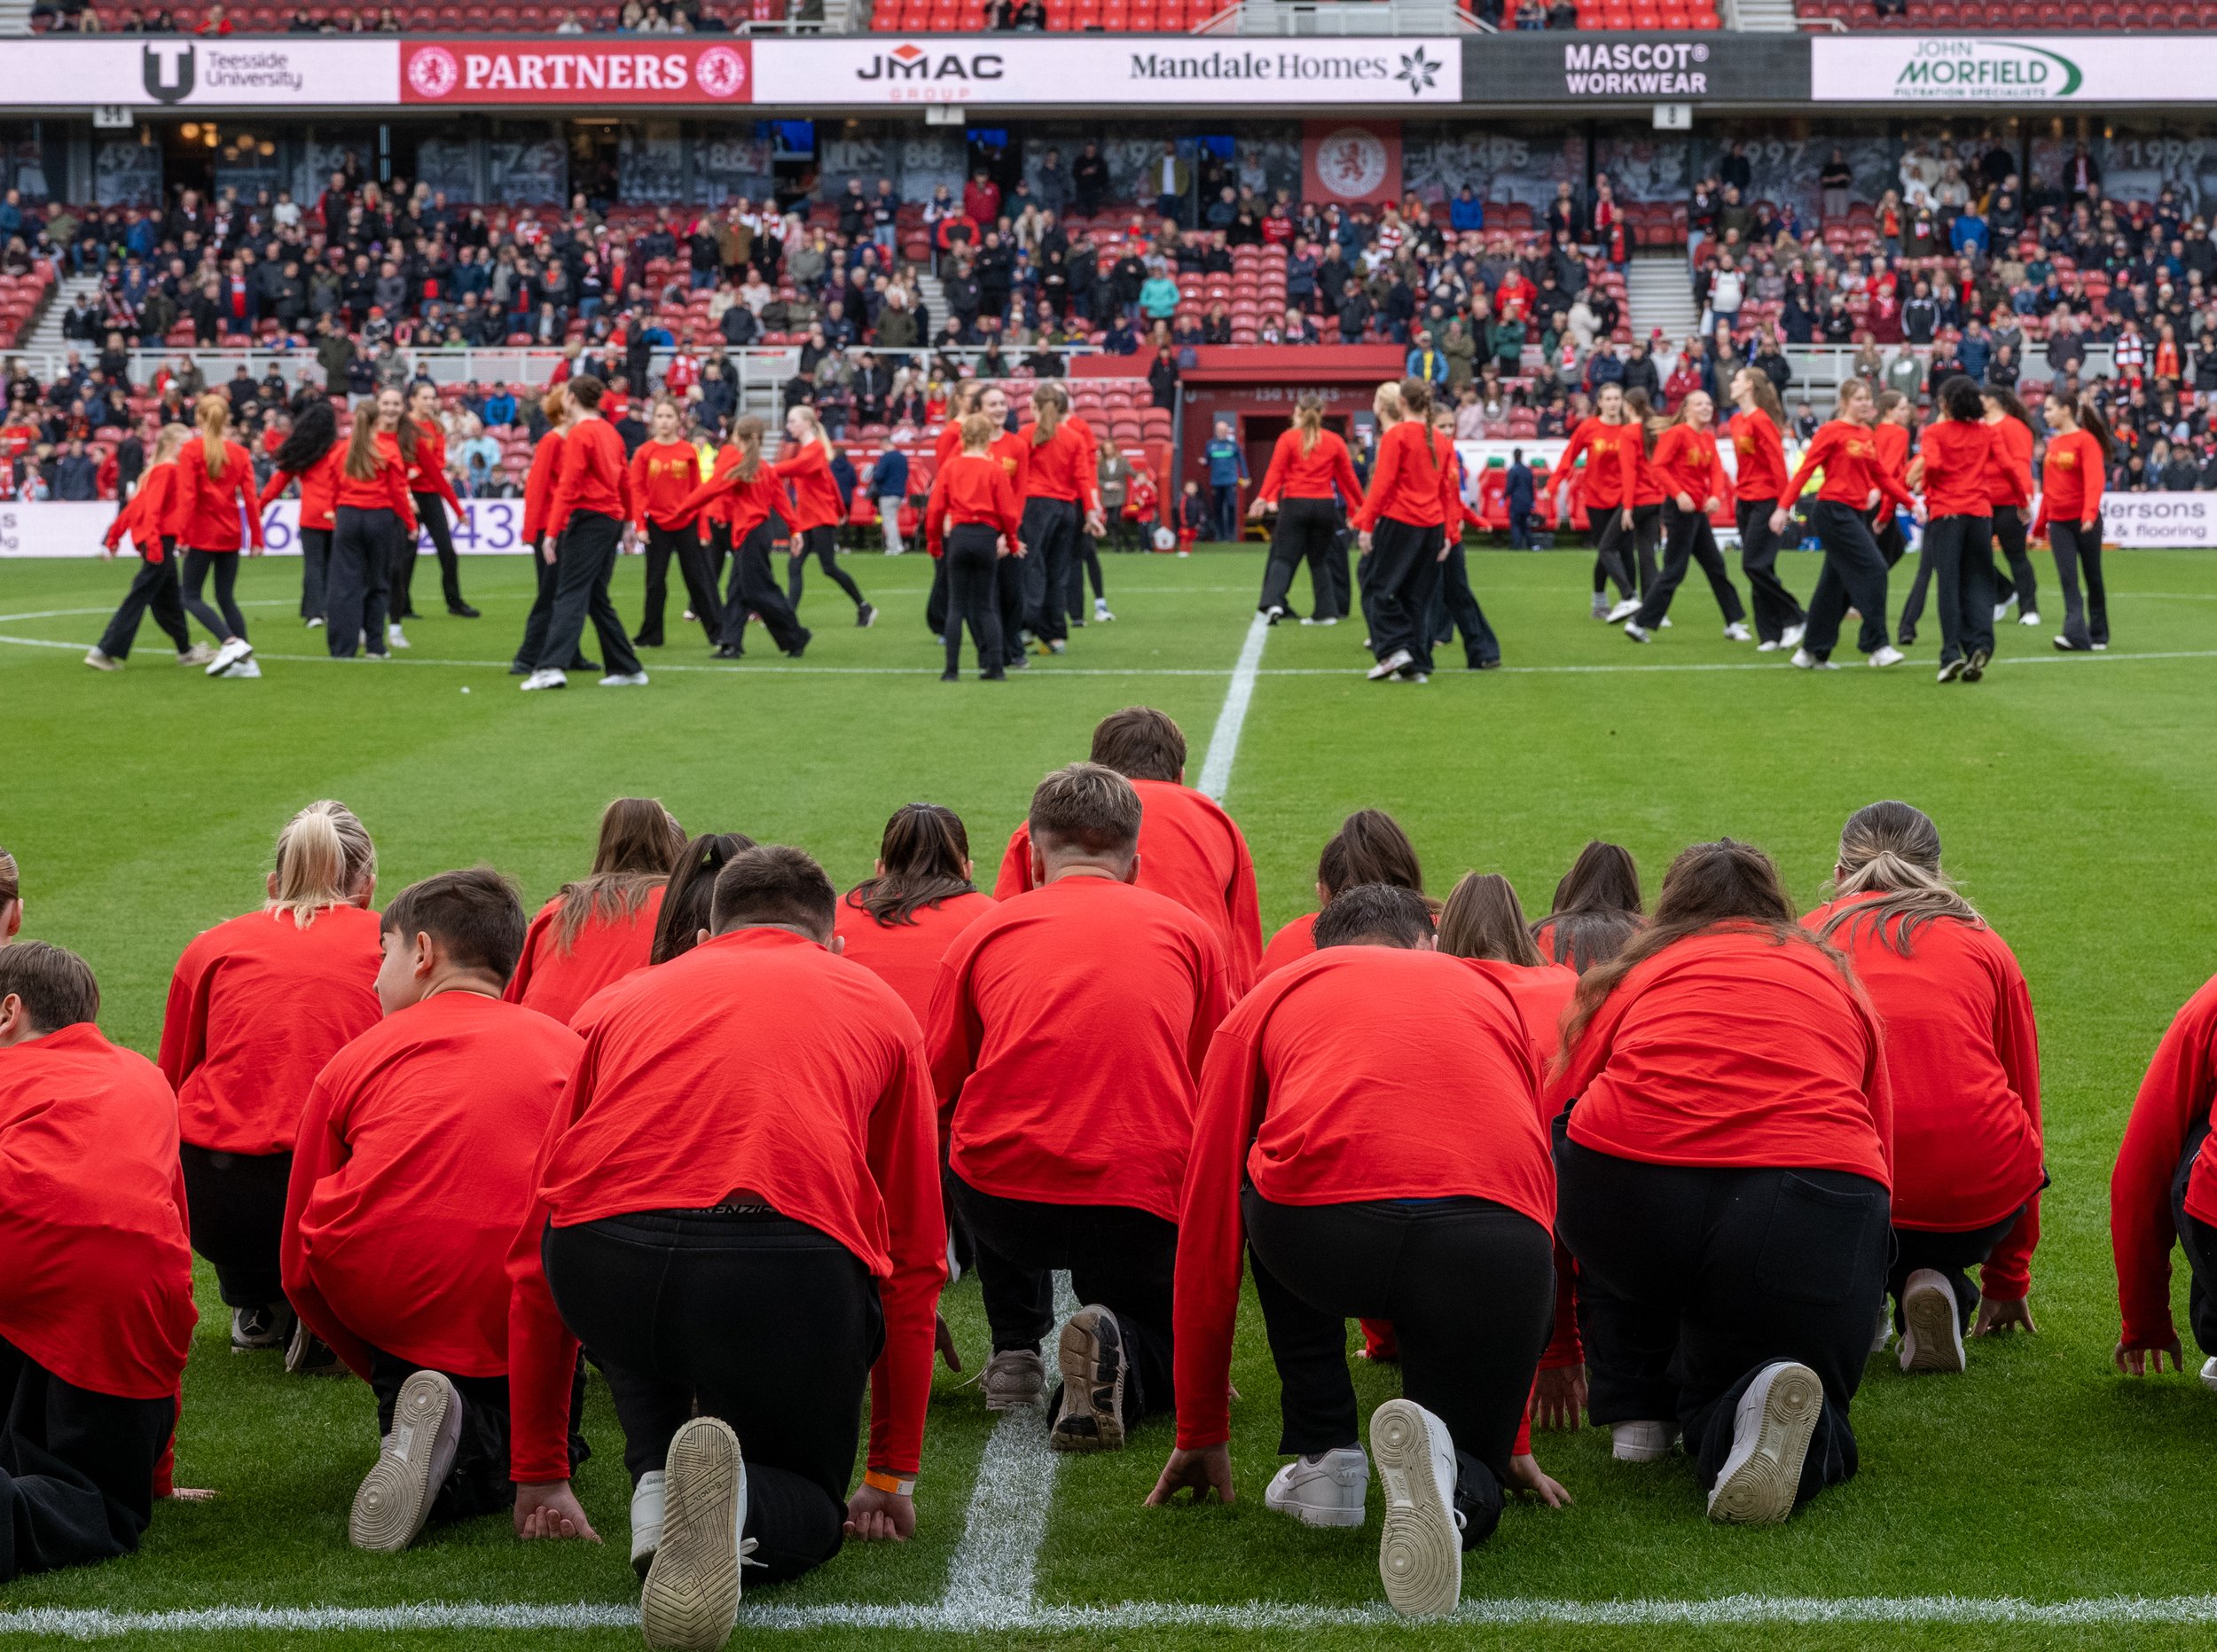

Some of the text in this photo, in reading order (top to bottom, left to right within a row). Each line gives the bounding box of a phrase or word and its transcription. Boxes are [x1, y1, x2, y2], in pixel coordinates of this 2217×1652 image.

[1914, 41, 1973, 58] JOHN
[208, 51, 289, 69] Teesside
[857, 55, 1004, 80] JMAC
[1130, 52, 1388, 79] Mandale Homes
[205, 71, 303, 91] University
[464, 54, 689, 90] PARTNERS
[1896, 60, 2049, 84] MORFIELD
[1565, 72, 1708, 94] WORKWEAR
[1894, 88, 2047, 97] FILTRATION SPECIALISTS
[889, 87, 971, 101] GROUP
[2114, 524, 2128, 538] &
[2136, 524, 2206, 539] flooring
[646, 1476, 665, 1485] Ben
